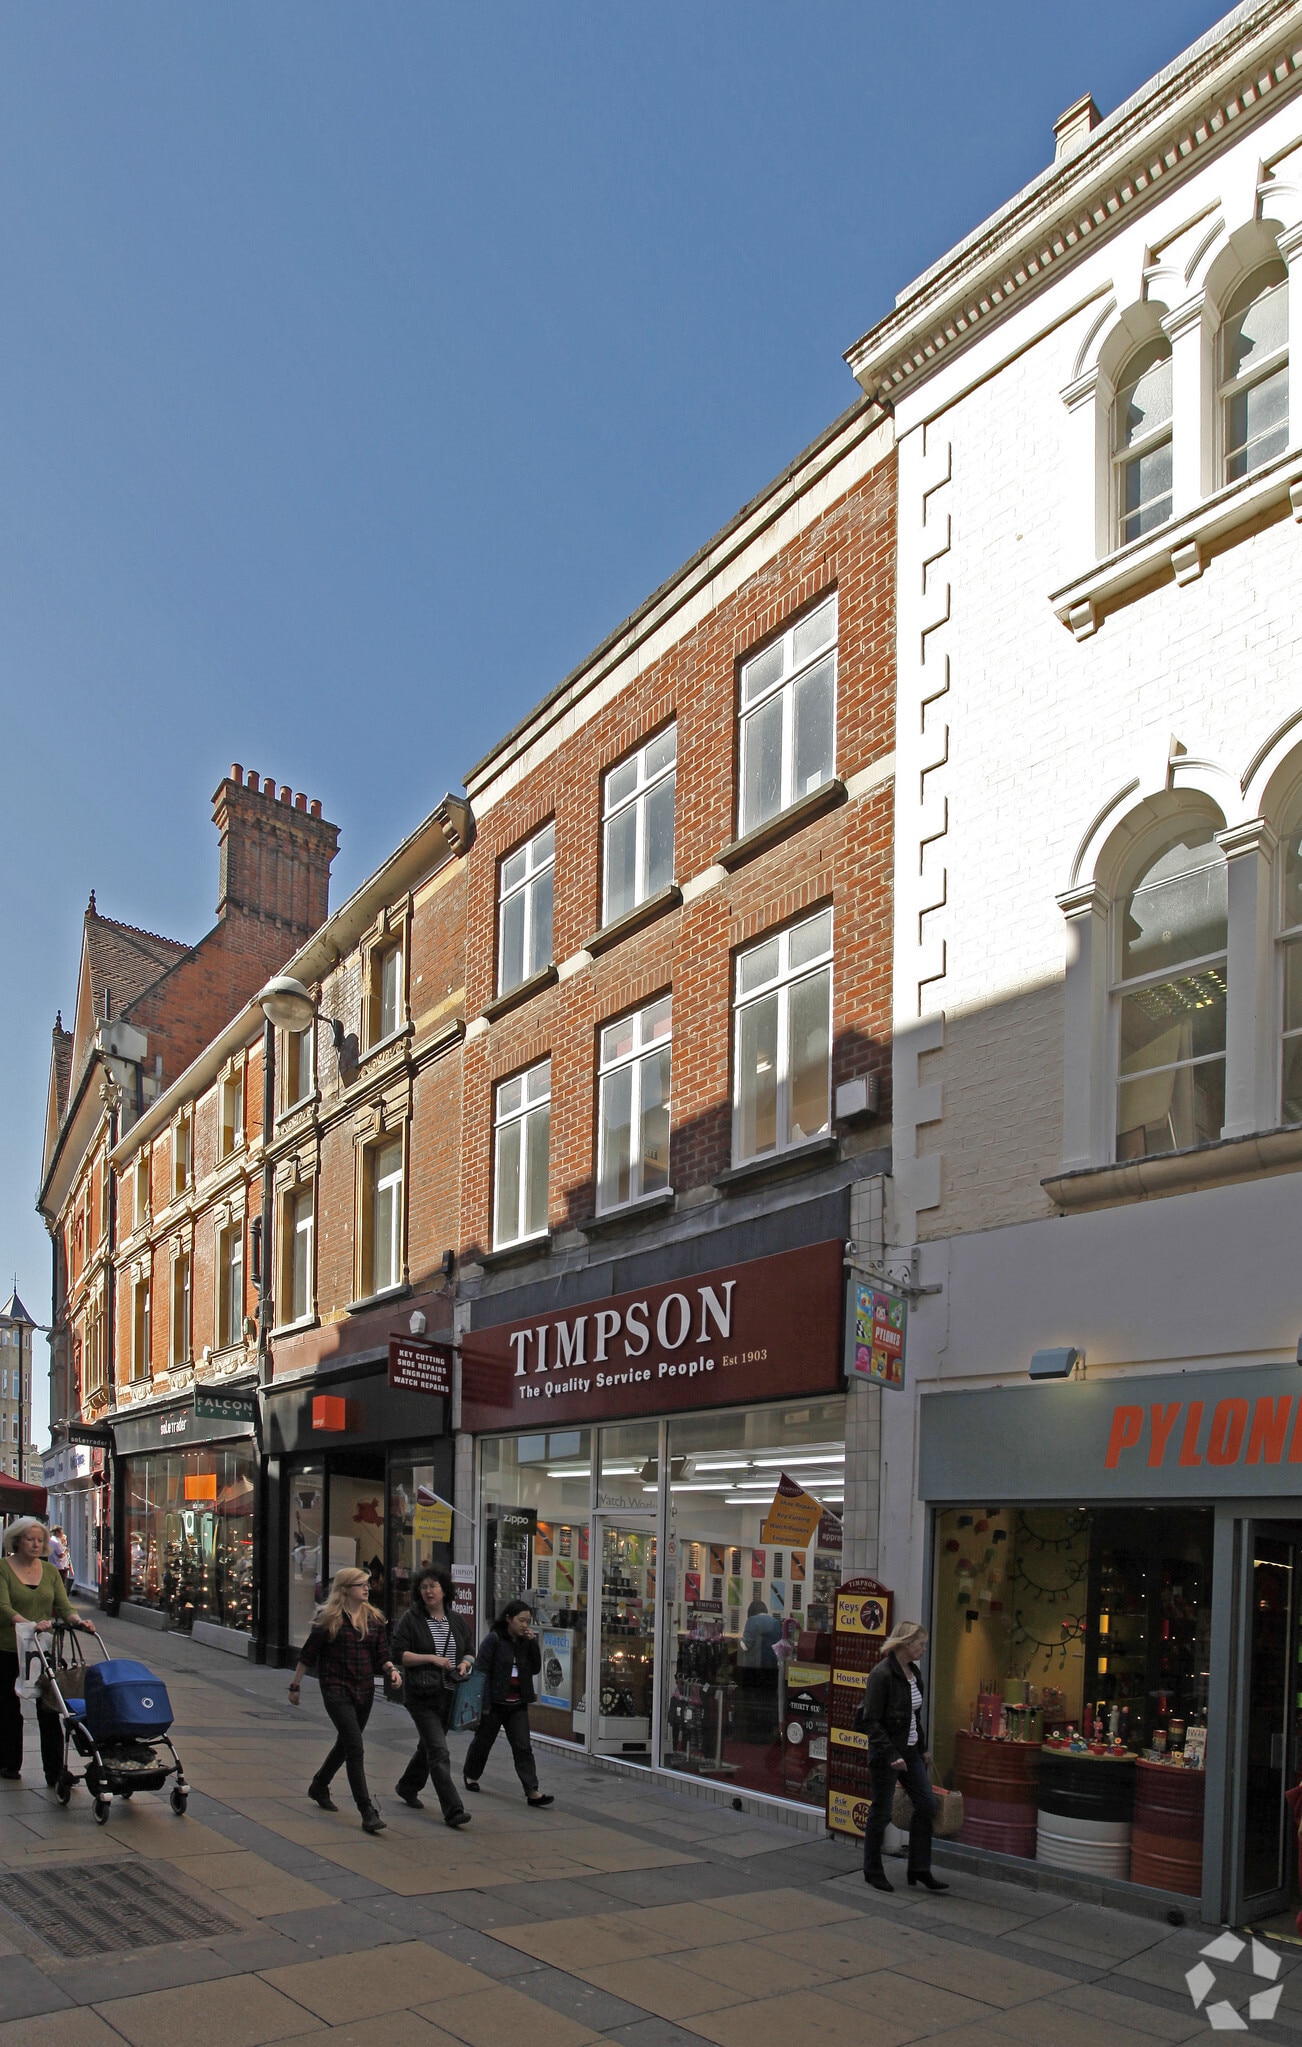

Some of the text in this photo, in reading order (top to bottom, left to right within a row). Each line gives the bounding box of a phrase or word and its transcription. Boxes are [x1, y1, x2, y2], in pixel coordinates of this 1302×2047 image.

[509, 1280, 737, 1377] TIMPSON
[875, 1326, 901, 1346] PYLONES
[399, 1350, 446, 1366] KEY CUTTING
[397, 1358, 447, 1375] SHOE REPAIRS
[519, 1349, 768, 1399] The Quality Service People Est 1903
[402, 1368, 442, 1383] ENGRAVING
[393, 1375, 450, 1393] WATCH REPAIRS
[197, 1397, 253, 1412] FALCON
[503, 1514, 529, 1526] zippo
[849, 1580, 877, 1590] TIMPSON
[451, 1600, 474, 1615] Repairs
[839, 1601, 859, 1613] Keys
[841, 1614, 856, 1626] Cut
[836, 1673, 860, 1683] House
[839, 1733, 852, 1743] Car
